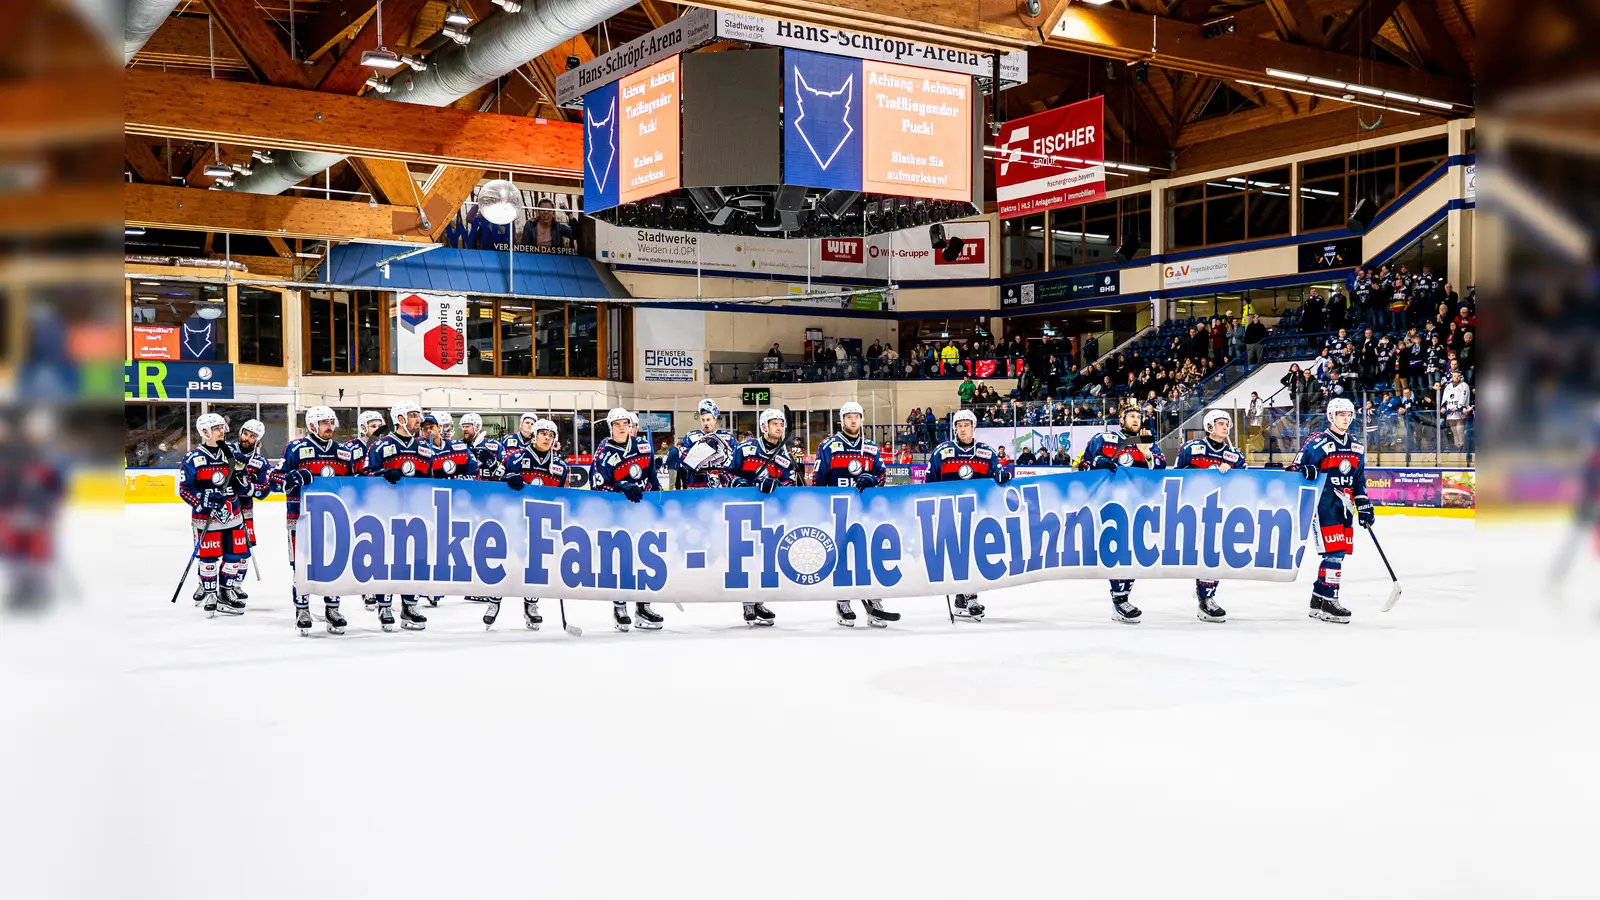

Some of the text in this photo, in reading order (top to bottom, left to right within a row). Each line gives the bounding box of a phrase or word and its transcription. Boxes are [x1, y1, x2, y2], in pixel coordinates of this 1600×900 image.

[725, 20, 764, 32] Stadtwerke
[578, 28, 682, 87] Hans-Schröpf-Arena
[987, 61, 1019, 72] Stwerke
[869, 72, 914, 92] Achtung
[922, 80, 965, 98] Achtung
[876, 94, 959, 118] Tieffliegender
[902, 119, 934, 135] Puck!
[1033, 126, 1095, 156] FISCHER
[891, 151, 944, 168] Bleiben Sie
[1047, 172, 1094, 188] fischergroup.bayern
[1001, 189, 1095, 213] Elektro HLS Anlagenbau Immobilien
[638, 230, 697, 245] Stadtwerke
[541, 246, 556, 254] DAS
[638, 244, 667, 254] Weiden
[827, 240, 857, 254] WITT
[880, 248, 929, 259] Wit-Gruppe
[1100, 285, 1115, 293] BHS
[438, 303, 450, 365] performing
[454, 310, 464, 365] databases
[657, 357, 693, 366] FUCHS
[189, 382, 222, 390] BHS
[838, 478, 857, 487] BH
[1330, 476, 1353, 486] BHS
[1366, 479, 1391, 487] GmbH
[304, 477, 1318, 592] Danke Fans - Frohe Weihnachten!
[800, 528, 834, 552] WEIDEN
[204, 581, 216, 589] 86
[796, 573, 821, 584] 1985
